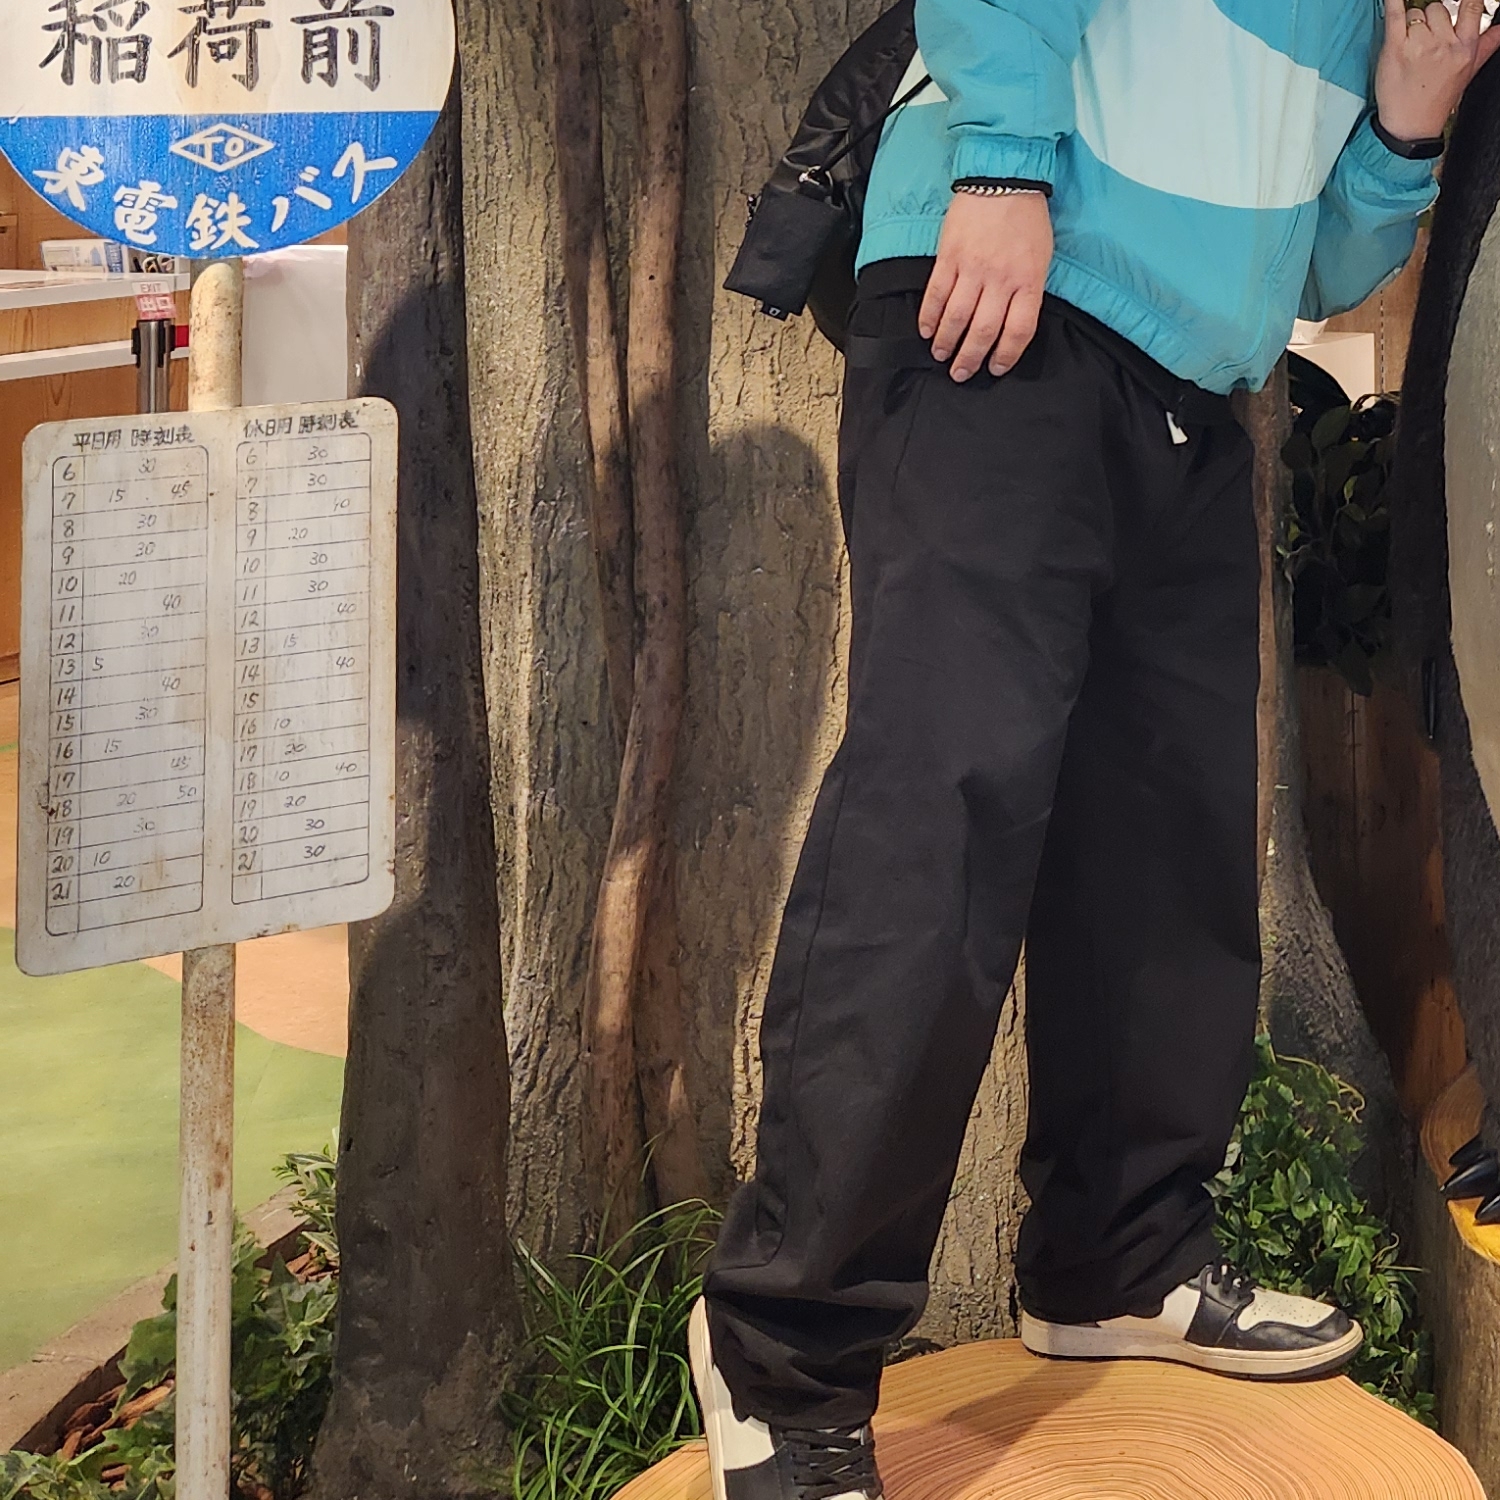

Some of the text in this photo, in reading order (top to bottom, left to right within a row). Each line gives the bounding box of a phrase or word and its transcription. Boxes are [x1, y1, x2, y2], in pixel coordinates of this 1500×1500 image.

[140, 283, 161, 293] EXIT
[243, 411, 361, 438] 休日用 時刻表
[72, 425, 195, 451] 平日用 時刻表
[246, 446, 329, 465] 6 30
[63, 464, 75, 480] 6
[245, 473, 327, 493] 7 30
[62, 480, 190, 510] 7 15 45
[247, 502, 259, 522] 8
[64, 514, 157, 537] 8 30
[247, 528, 308, 547] 9 20
[62, 541, 155, 565] 9 30
[243, 552, 328, 574] 10 30
[58, 571, 137, 593] 10 20
[243, 580, 329, 601] 11 30
[59, 594, 181, 622] 11 40
[241, 602, 356, 628] 12 40
[57, 631, 75, 649] 12
[241, 634, 300, 656] 13 15
[57, 656, 103, 676] 13 5
[241, 656, 355, 682] 14 40
[57, 676, 181, 705] 14 40
[240, 692, 258, 710] 15
[57, 713, 75, 732] 15
[240, 718, 290, 735] 16 10
[56, 738, 122, 760] 16 15
[240, 742, 306, 762] 17 20
[55, 772, 75, 789] 17
[240, 762, 357, 791] 18 10 40
[53, 784, 197, 818] 18 20 50
[240, 795, 306, 818] 19 20
[54, 818, 155, 845] 19 30
[239, 819, 325, 844] 20 30
[52, 851, 111, 873] 20 10
[238, 844, 326, 871] 21 30
[52, 875, 135, 900] 21 20
